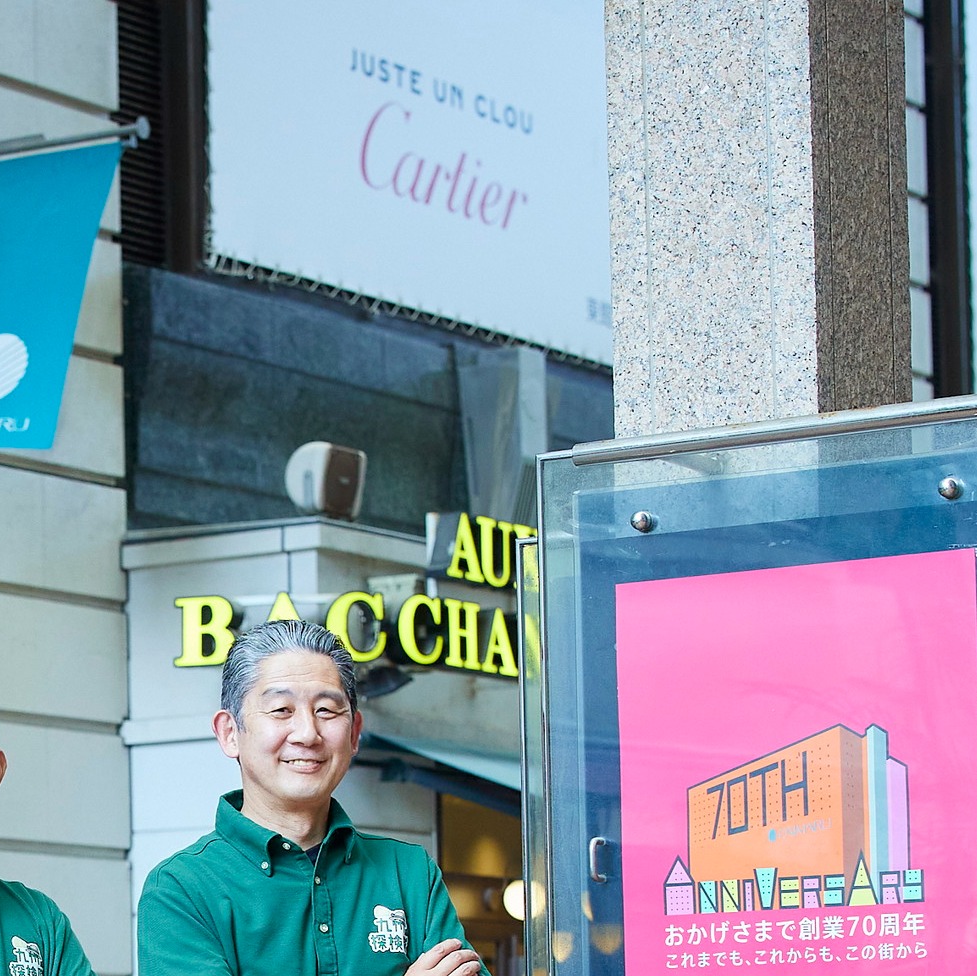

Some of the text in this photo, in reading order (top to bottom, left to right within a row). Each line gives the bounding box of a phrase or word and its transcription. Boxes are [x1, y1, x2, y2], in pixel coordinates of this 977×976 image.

[350, 49, 534, 135] JUSTE UN CLOU
[360, 100, 528, 230] Cartier
[706, 751, 809, 840] 70TH
[664, 911, 926, 947] おかげさまで創業70周年
[665, 941, 928, 970] これまでも、これからも、この街から
